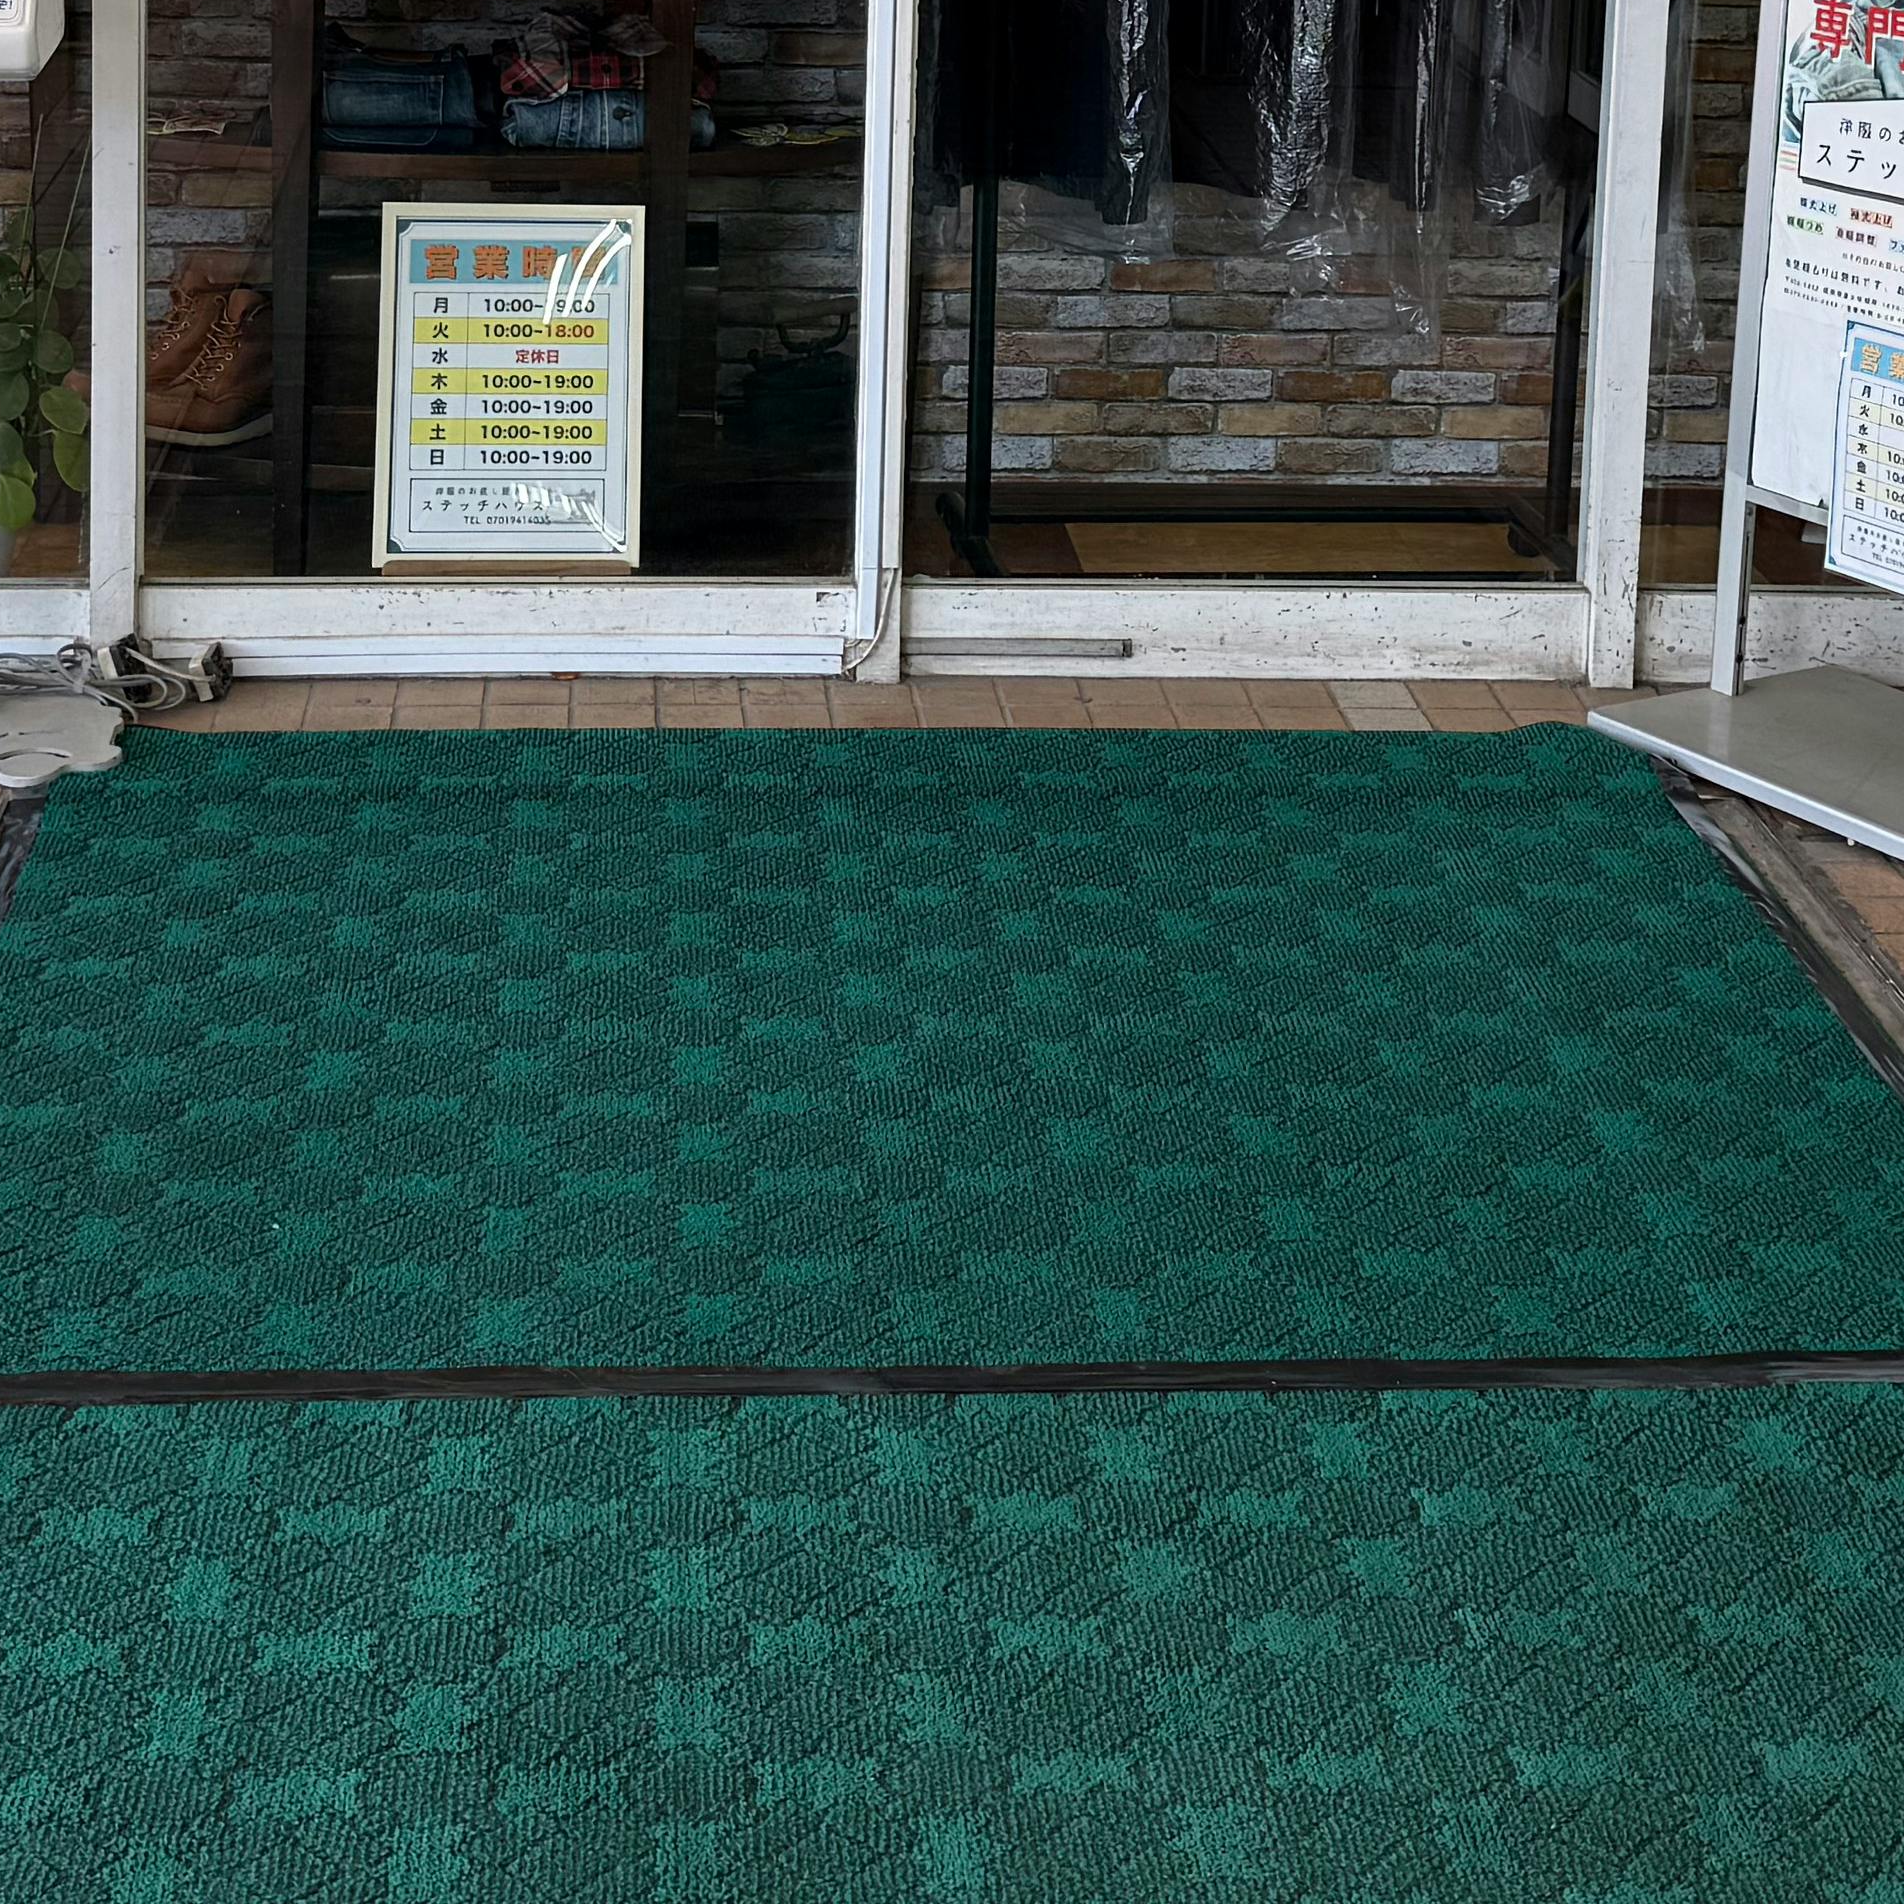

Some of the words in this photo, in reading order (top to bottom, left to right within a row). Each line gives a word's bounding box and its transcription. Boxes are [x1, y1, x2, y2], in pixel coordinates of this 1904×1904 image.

[434, 297, 449, 314] 月
[433, 322, 450, 340] 火
[484, 323, 595, 340] 10:00~18:00
[432, 348, 448, 365] 水
[515, 349, 560, 365] 定休日
[431, 373, 448, 390] 木
[482, 374, 594, 390] 10:00~19:00
[430, 398, 447, 415] 金
[482, 399, 594, 415] 10:00~19:00
[430, 424, 446, 441] 土
[481, 425, 593, 440] 10:00~19:00
[431, 450, 445, 465] 日
[480, 450, 592, 466] 10:00~19:00
[464, 516, 481, 525] TEL
